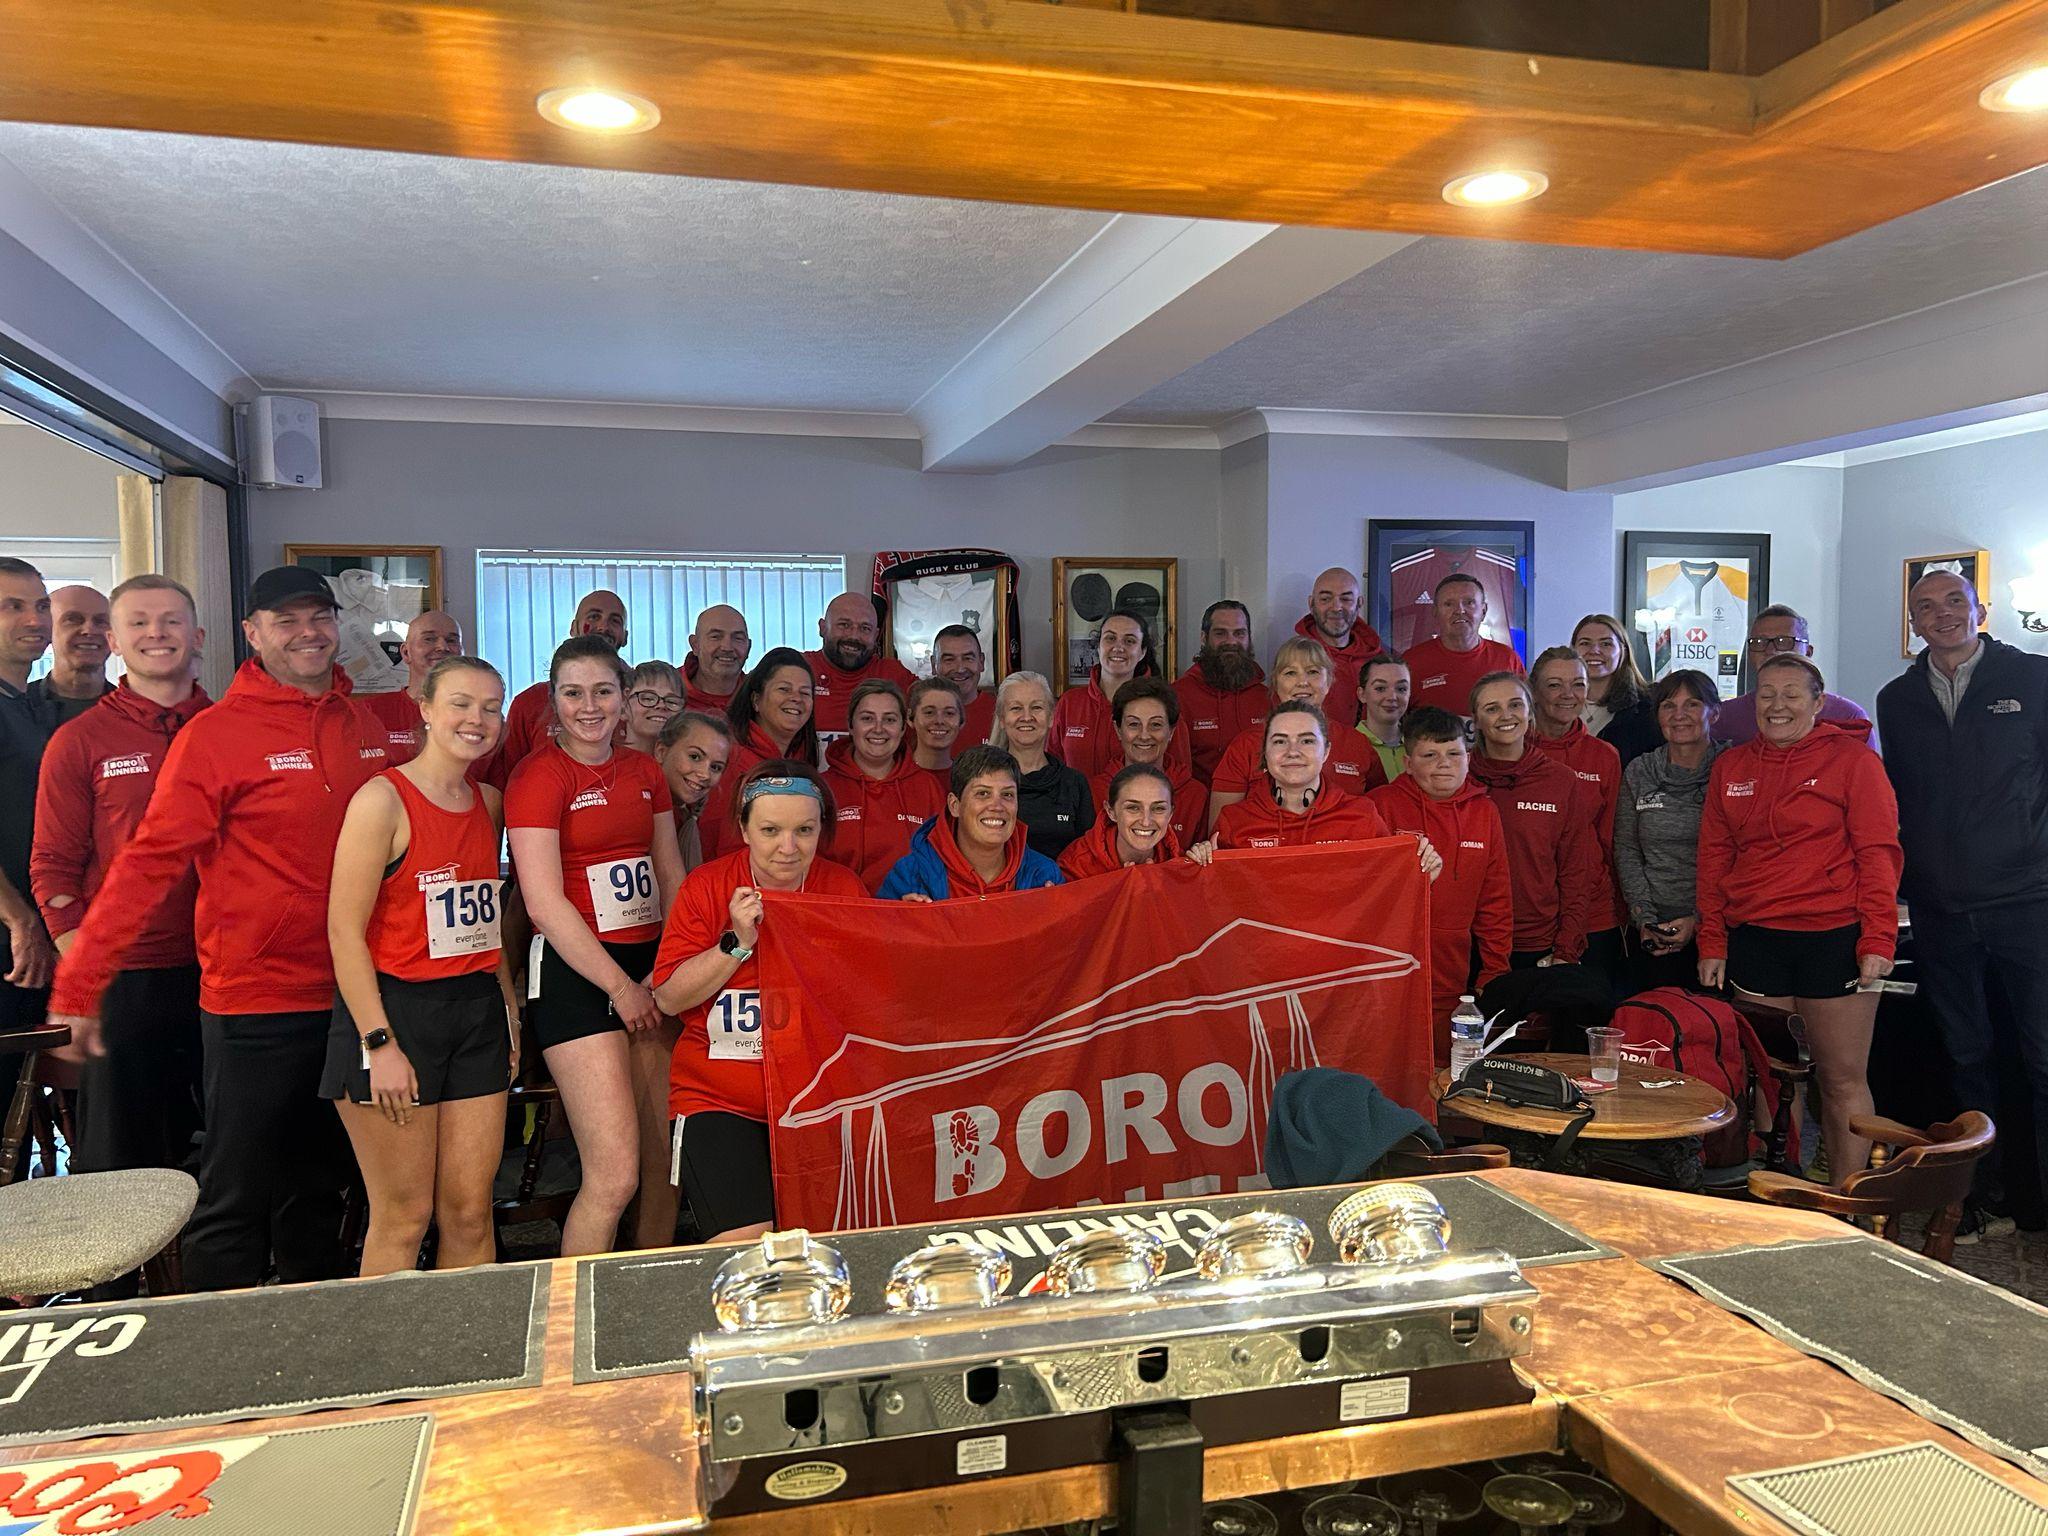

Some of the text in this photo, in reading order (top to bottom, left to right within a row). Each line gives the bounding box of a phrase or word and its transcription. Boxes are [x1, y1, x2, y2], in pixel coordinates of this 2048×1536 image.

[916, 562, 979, 576] RUGBY CLUB
[1677, 644, 1716, 660] HSBC
[360, 748, 386, 759] DAVID
[109, 759, 138, 769] BORO
[270, 761, 314, 771] RUNNERS
[275, 756, 303, 764] BORO
[103, 765, 150, 778] RUNNERS
[576, 792, 598, 802] BORO
[570, 798, 608, 811] RUNNERS
[1517, 801, 1557, 813] RACHEL
[1057, 814, 1070, 822] EW
[425, 872, 451, 883] BORO
[609, 860, 652, 902] 96
[435, 882, 496, 928] 158
[1483, 1059, 1535, 1075] KARRIMOR
[932, 1062, 1248, 1203] BORO
